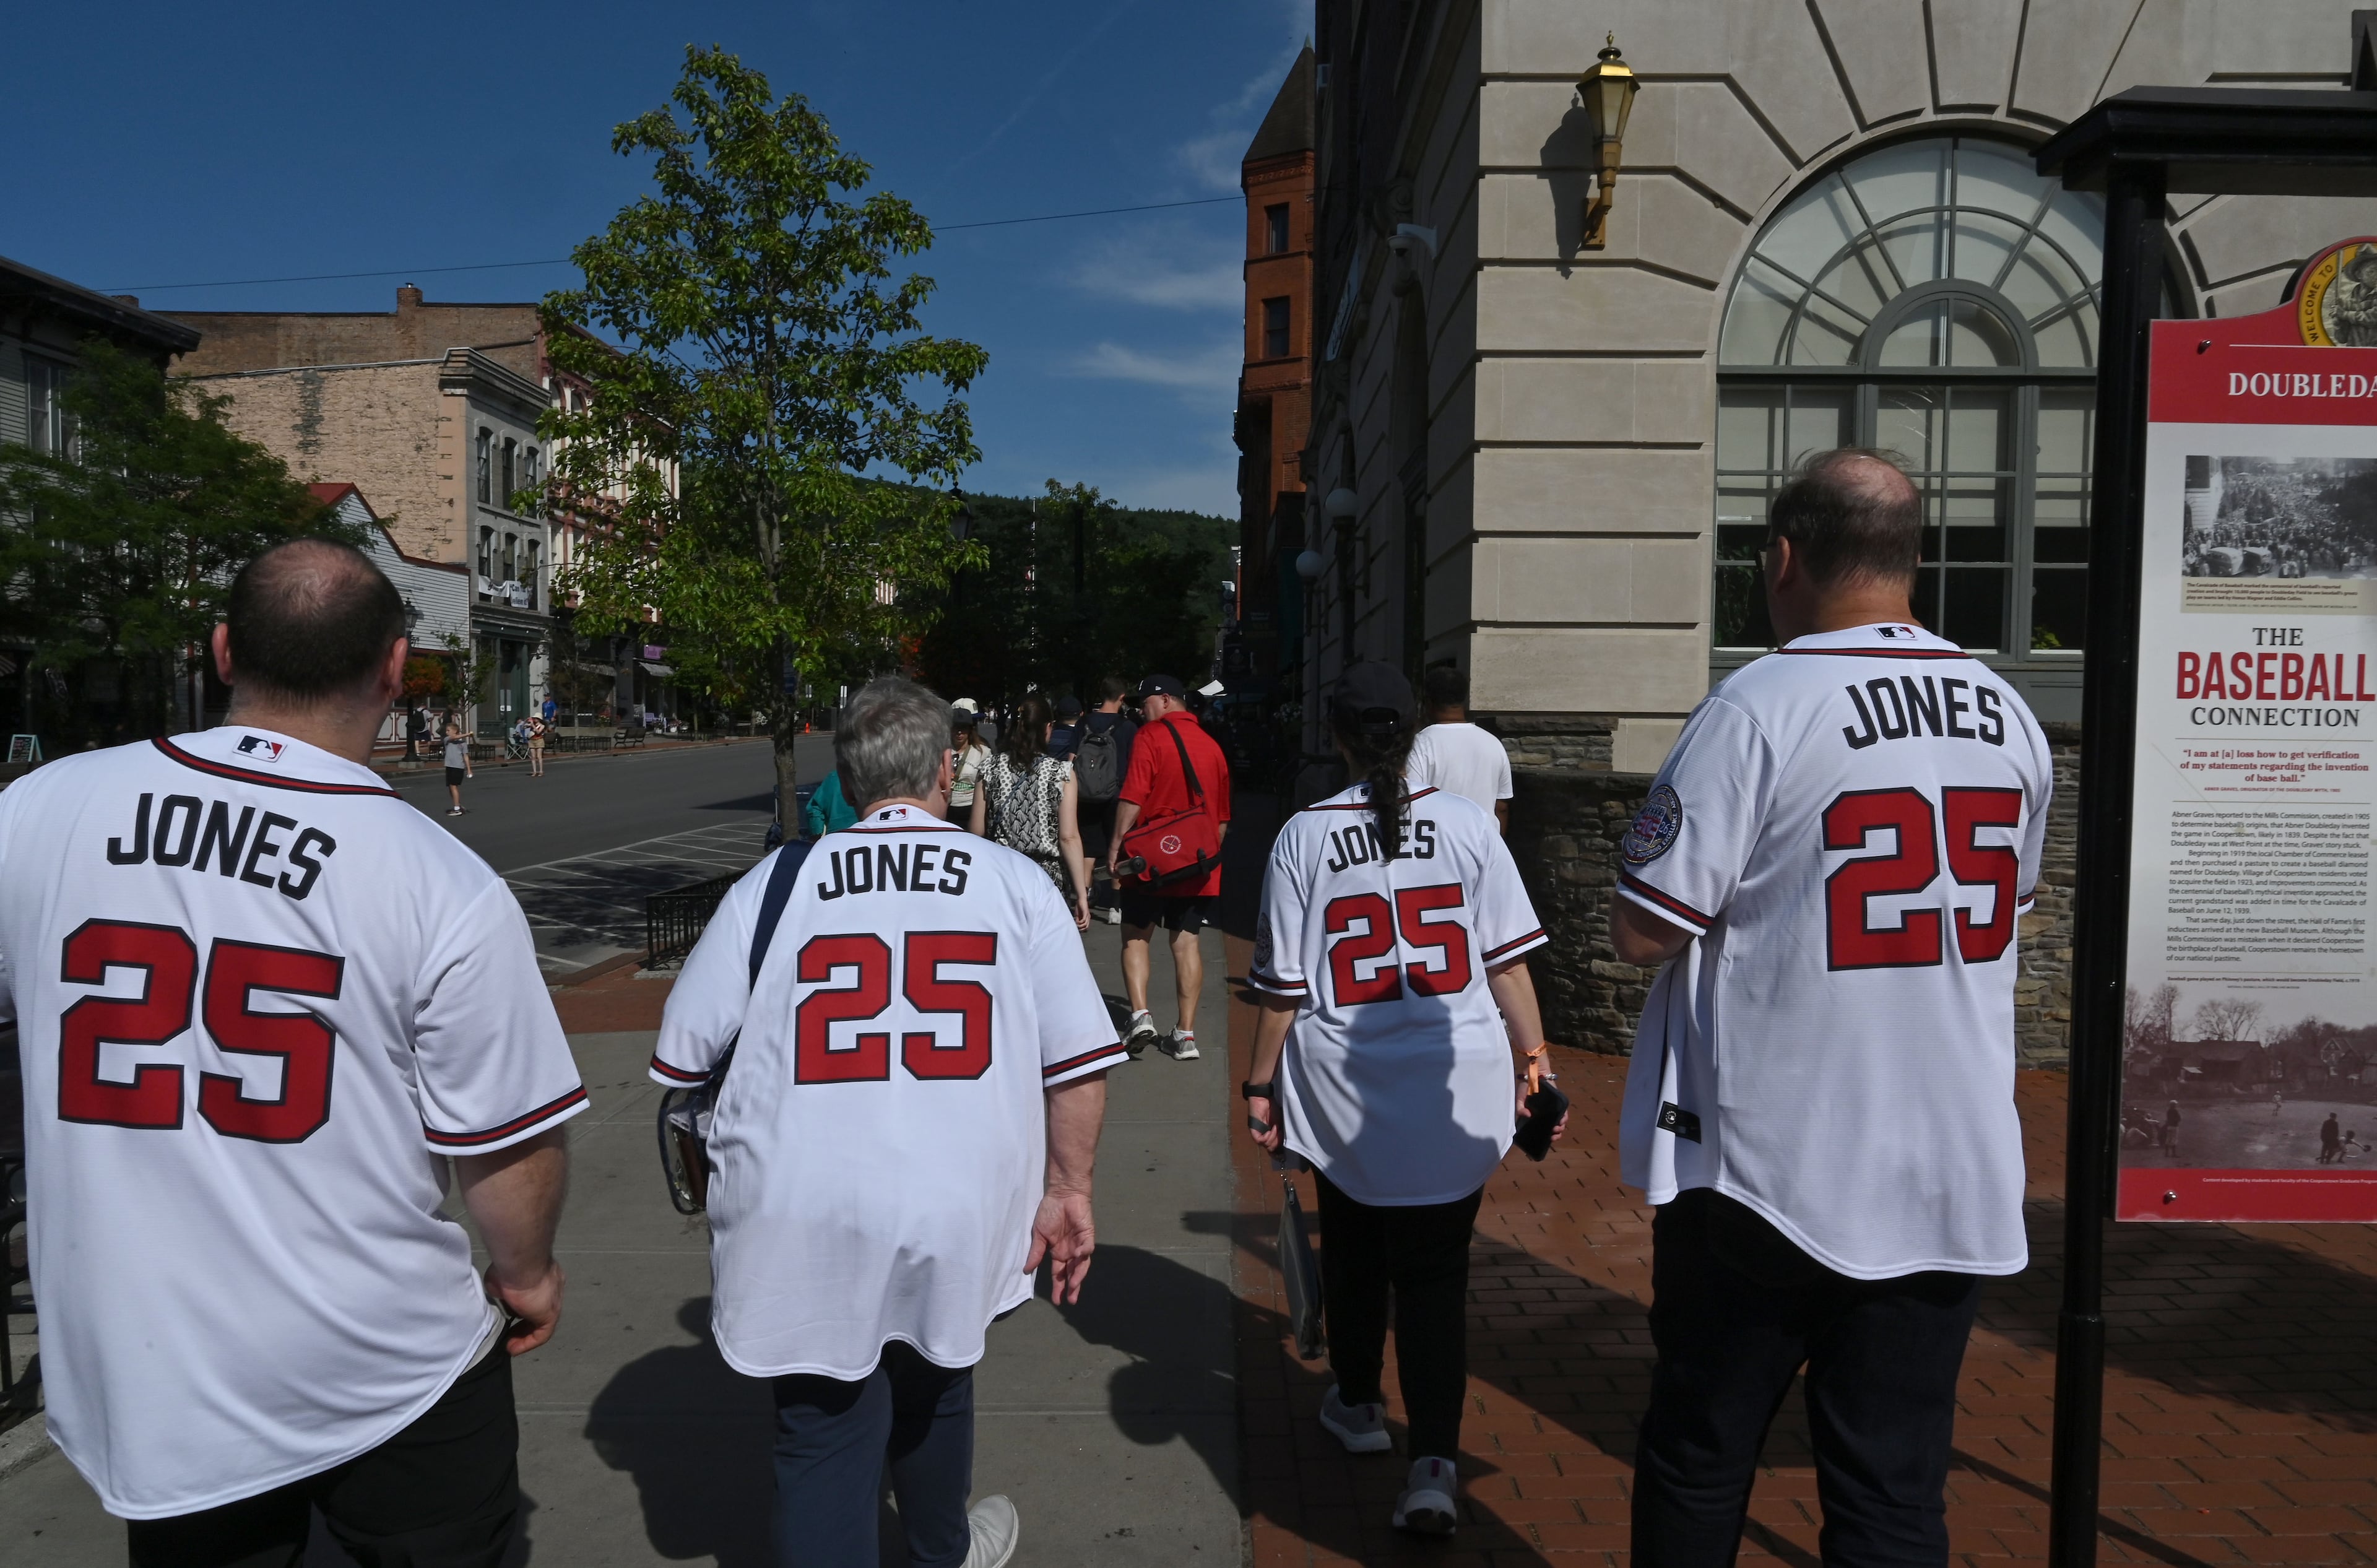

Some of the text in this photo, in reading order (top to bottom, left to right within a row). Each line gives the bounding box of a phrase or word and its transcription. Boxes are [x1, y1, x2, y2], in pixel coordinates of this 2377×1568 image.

[2305, 264, 2333, 342] WELCOME TO
[2252, 628, 2303, 646] THE
[2176, 652, 2376, 701] BASEBALL
[1842, 675, 2005, 750] JONES
[2190, 707, 2360, 727] CONNECTION
[2222, 750, 2233, 760] [a]
[2290, 751, 2304, 760] get
[2260, 763, 2305, 771] regarding
[2215, 812, 2243, 820] reported
[1658, 821, 1669, 834] 26
[1662, 812, 1678, 846] EXCELLENCE
[2305, 822, 2340, 830] Doubleday
[2258, 831, 2274, 839] likely
[2303, 831, 2328, 839] Despite
[106, 793, 337, 901] JONES
[2170, 840, 2206, 848] Doubleday
[2325, 841, 2342, 849] story
[2188, 849, 2221, 858] Beginning
[2202, 859, 2236, 867] purchased
[2245, 860, 2269, 868] pasture
[818, 844, 972, 901] JONES
[2242, 869, 2264, 877] Village
[2273, 869, 2316, 878] Cooperstown
[1821, 786, 2023, 971] 25
[2176, 878, 2201, 886] acquire
[2269, 879, 2315, 887] improvements
[2254, 888, 2282, 896] mythical
[2194, 898, 2233, 906] grandstand
[2232, 917, 2245, 925] just
[1323, 882, 1472, 1008] 25
[794, 931, 998, 1085] 25
[58, 918, 345, 1143] 25
